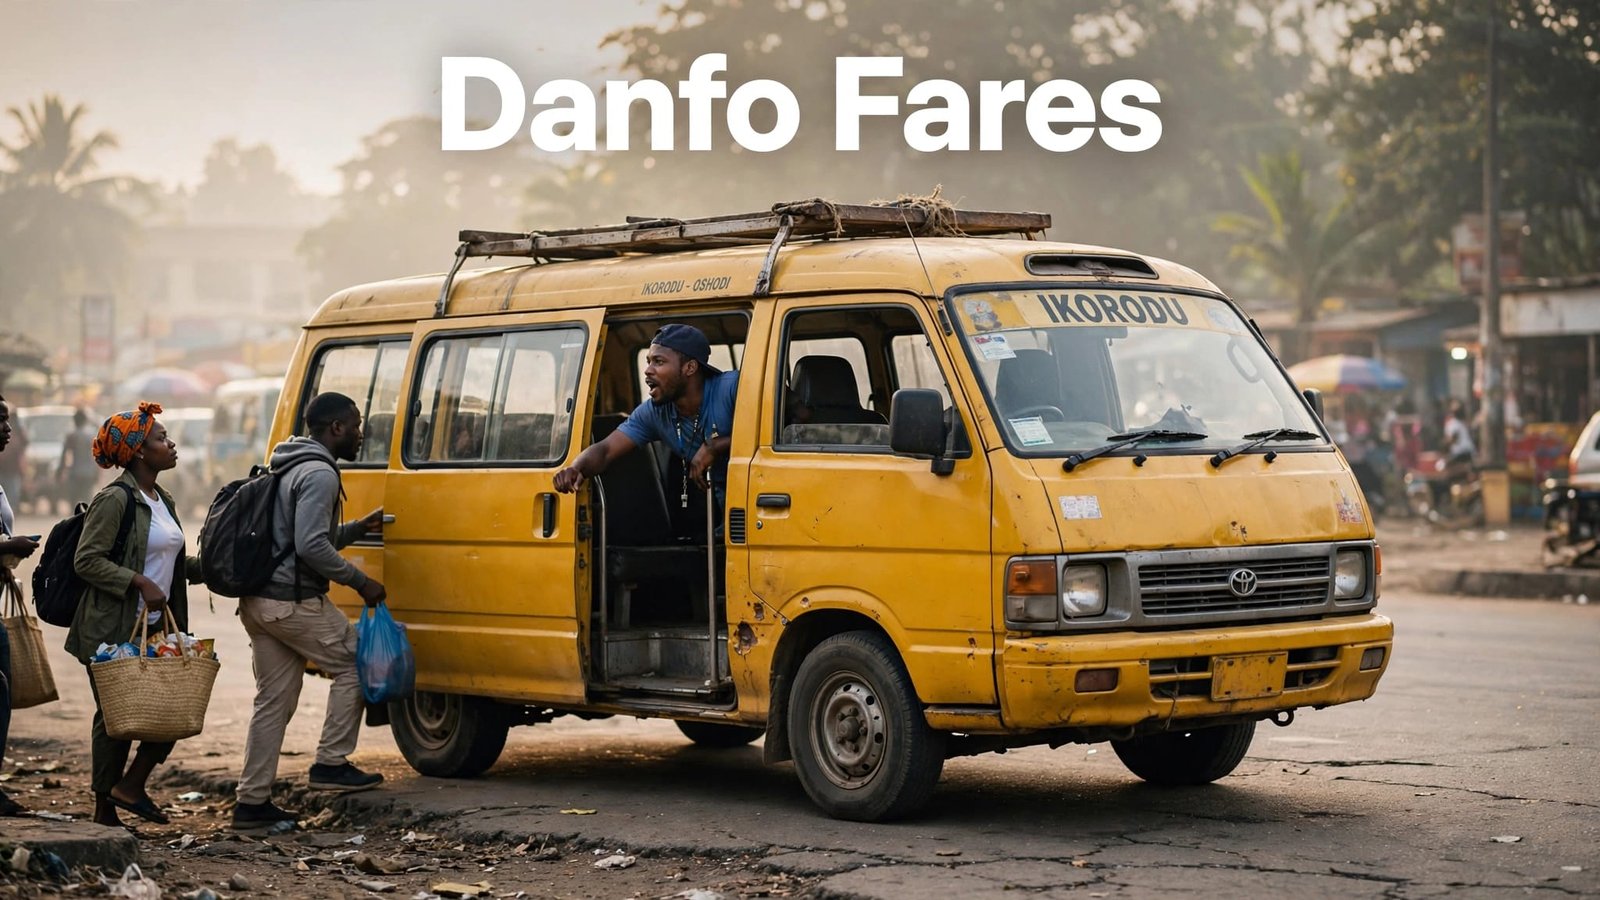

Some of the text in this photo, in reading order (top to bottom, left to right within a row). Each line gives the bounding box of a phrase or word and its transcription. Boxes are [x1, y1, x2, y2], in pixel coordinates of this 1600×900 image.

[641, 280, 685, 295] IKORODU
[693, 277, 731, 291] OSHODI
[1036, 293, 1189, 326] IKORODU
